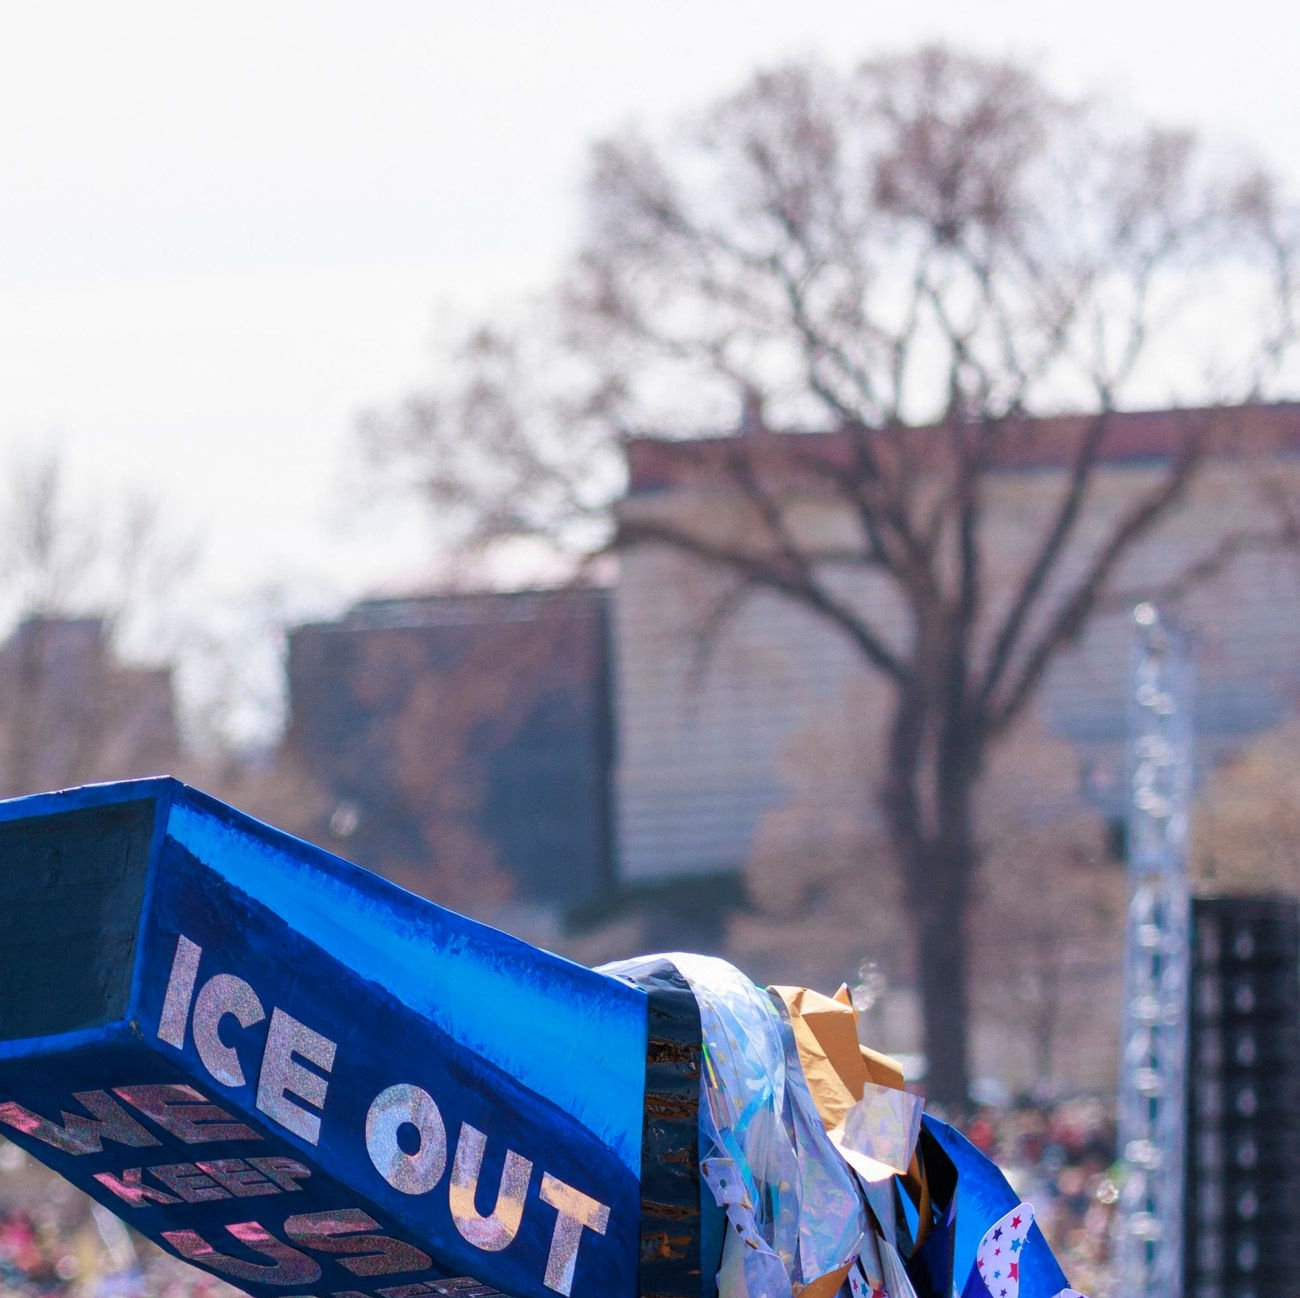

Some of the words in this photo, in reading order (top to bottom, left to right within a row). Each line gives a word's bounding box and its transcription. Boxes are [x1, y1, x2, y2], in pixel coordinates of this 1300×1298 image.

[156, 934, 337, 1146] ICE
[365, 1083, 611, 1297] OUT
[93, 1156, 312, 1208] KEEP
[161, 1208, 433, 1285] US
